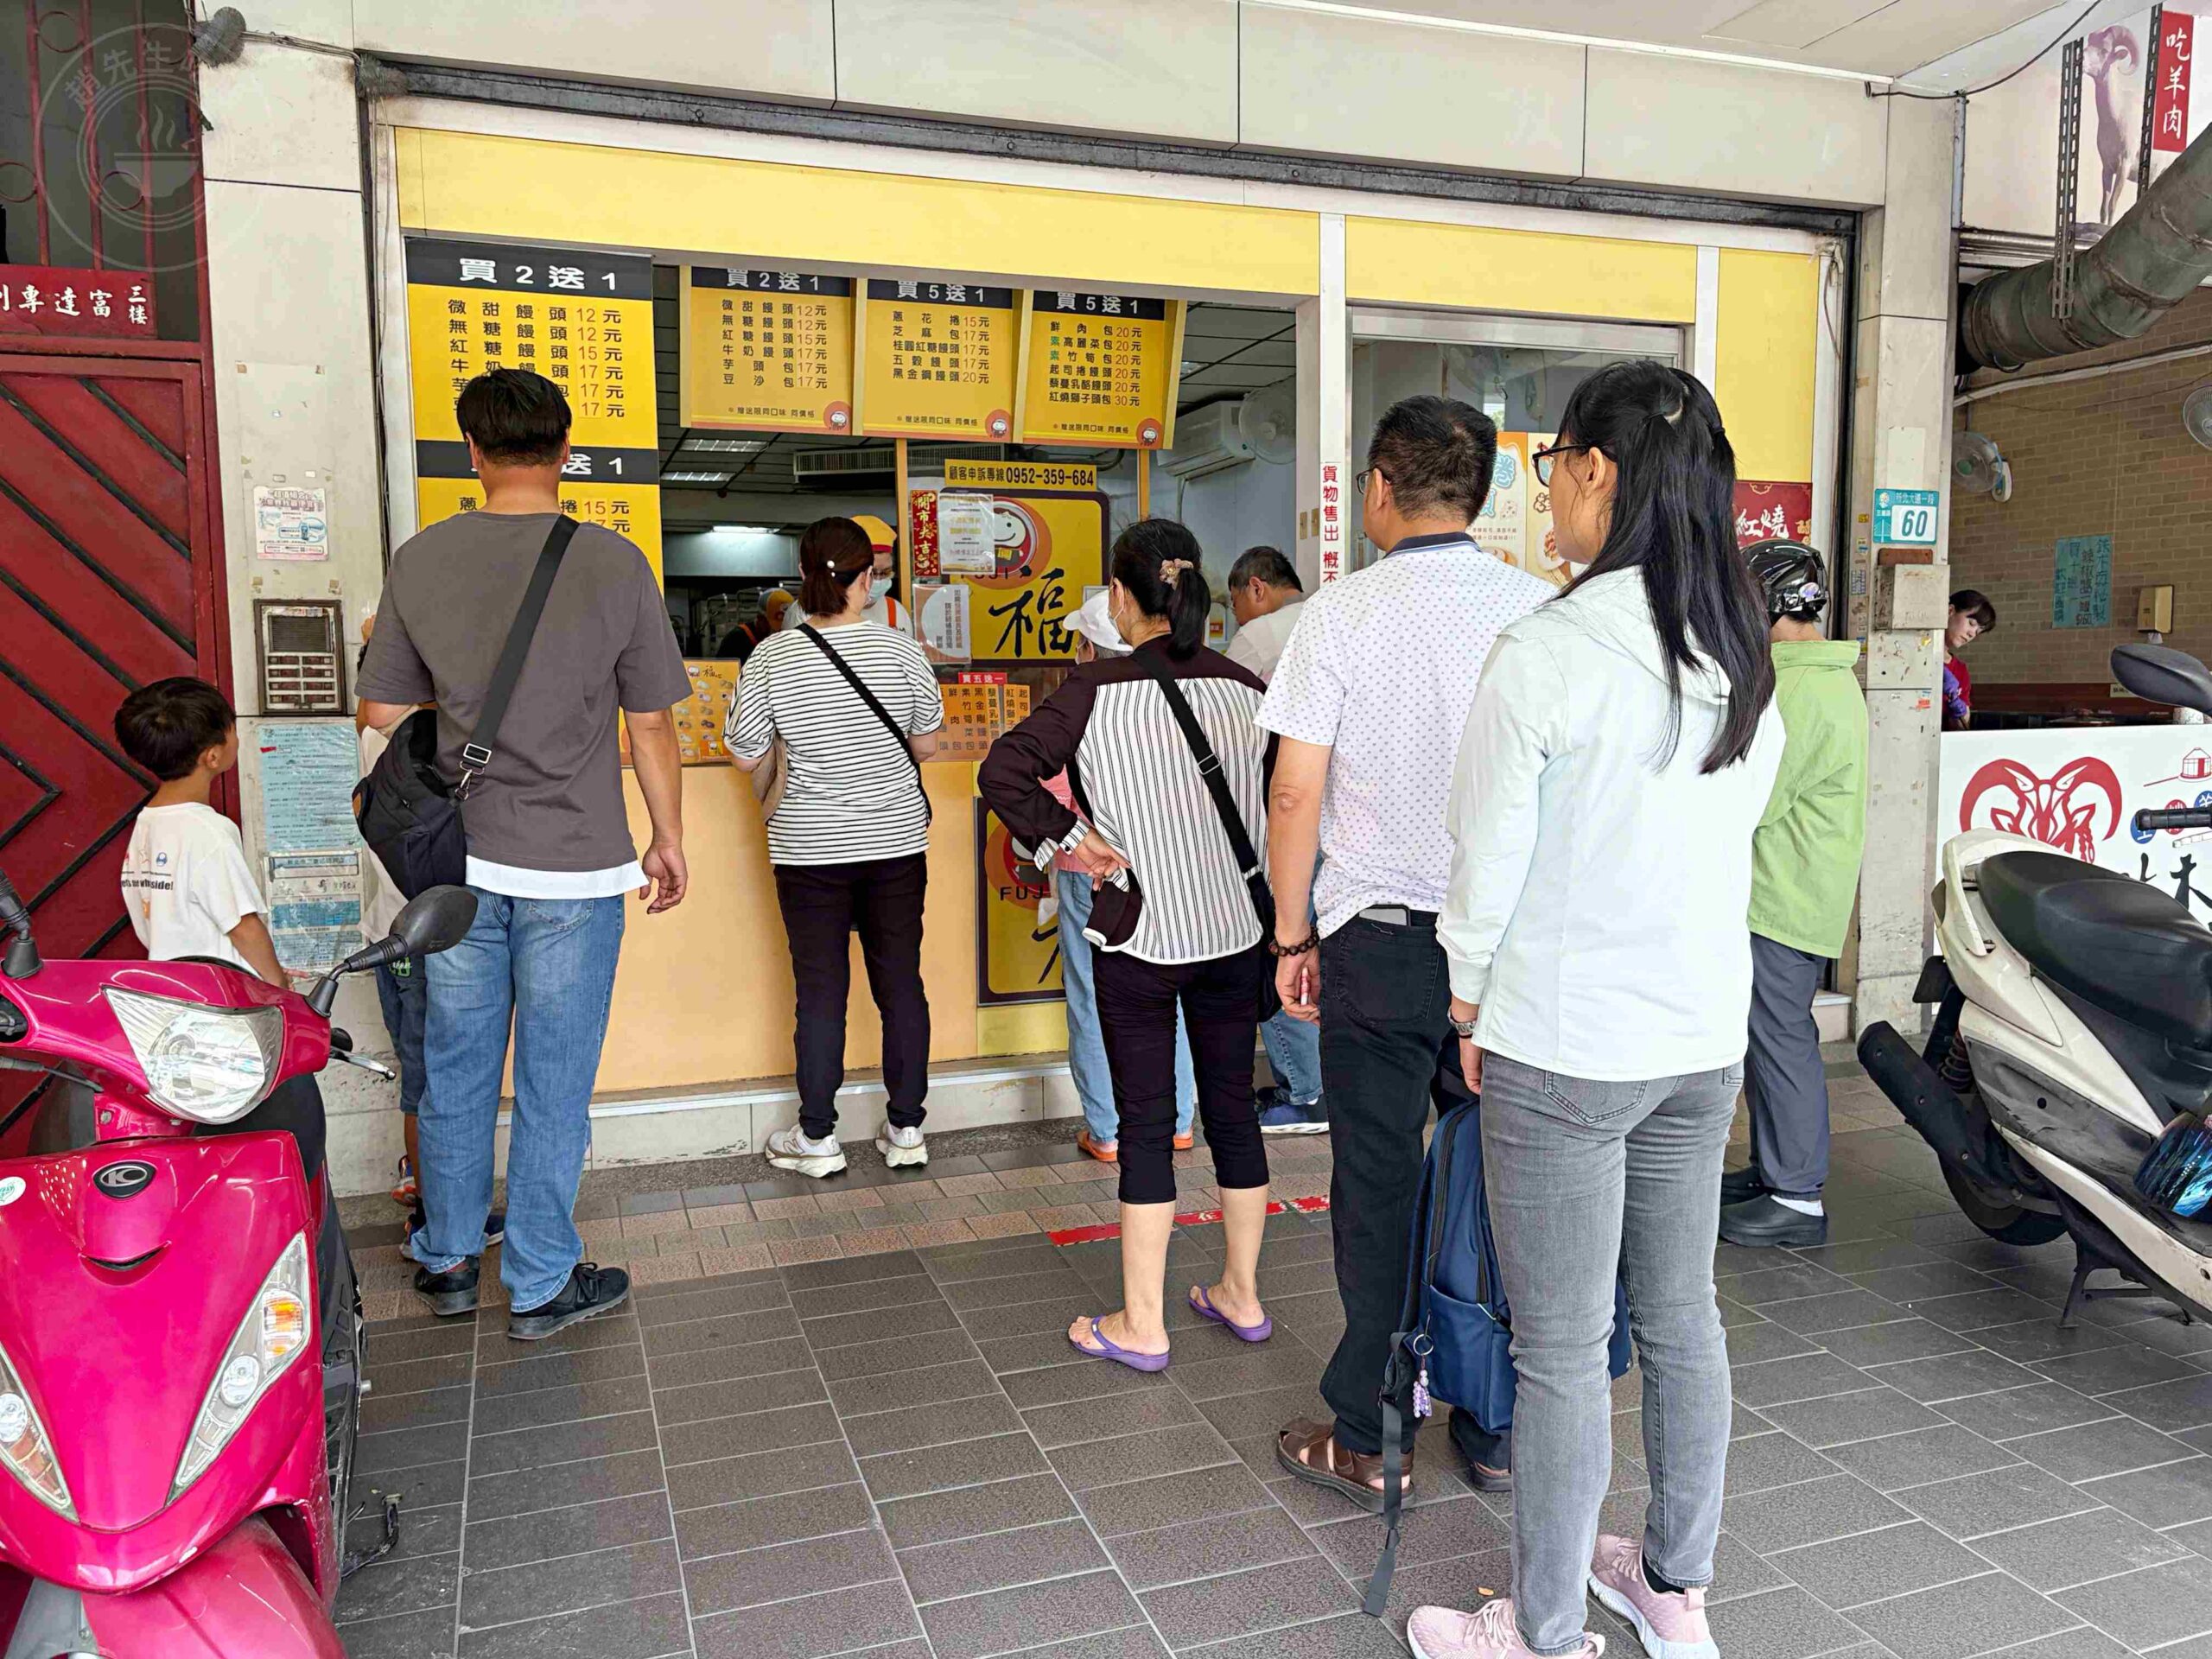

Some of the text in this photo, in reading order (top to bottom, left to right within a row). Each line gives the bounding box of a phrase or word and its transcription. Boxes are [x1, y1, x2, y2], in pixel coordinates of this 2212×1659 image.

[2163, 28, 2190, 140] 吃羊肉
[459, 257, 617, 290] 買2送1
[726, 268, 819, 291] 買2送1
[896, 280, 985, 303] 買5送1
[1056, 292, 1139, 314] 買5送1
[1006, 467, 1094, 486] 0952-359-684
[1736, 504, 1789, 539] 紅燒
[1902, 510, 1928, 537] 60
[988, 566, 1074, 658] 福
